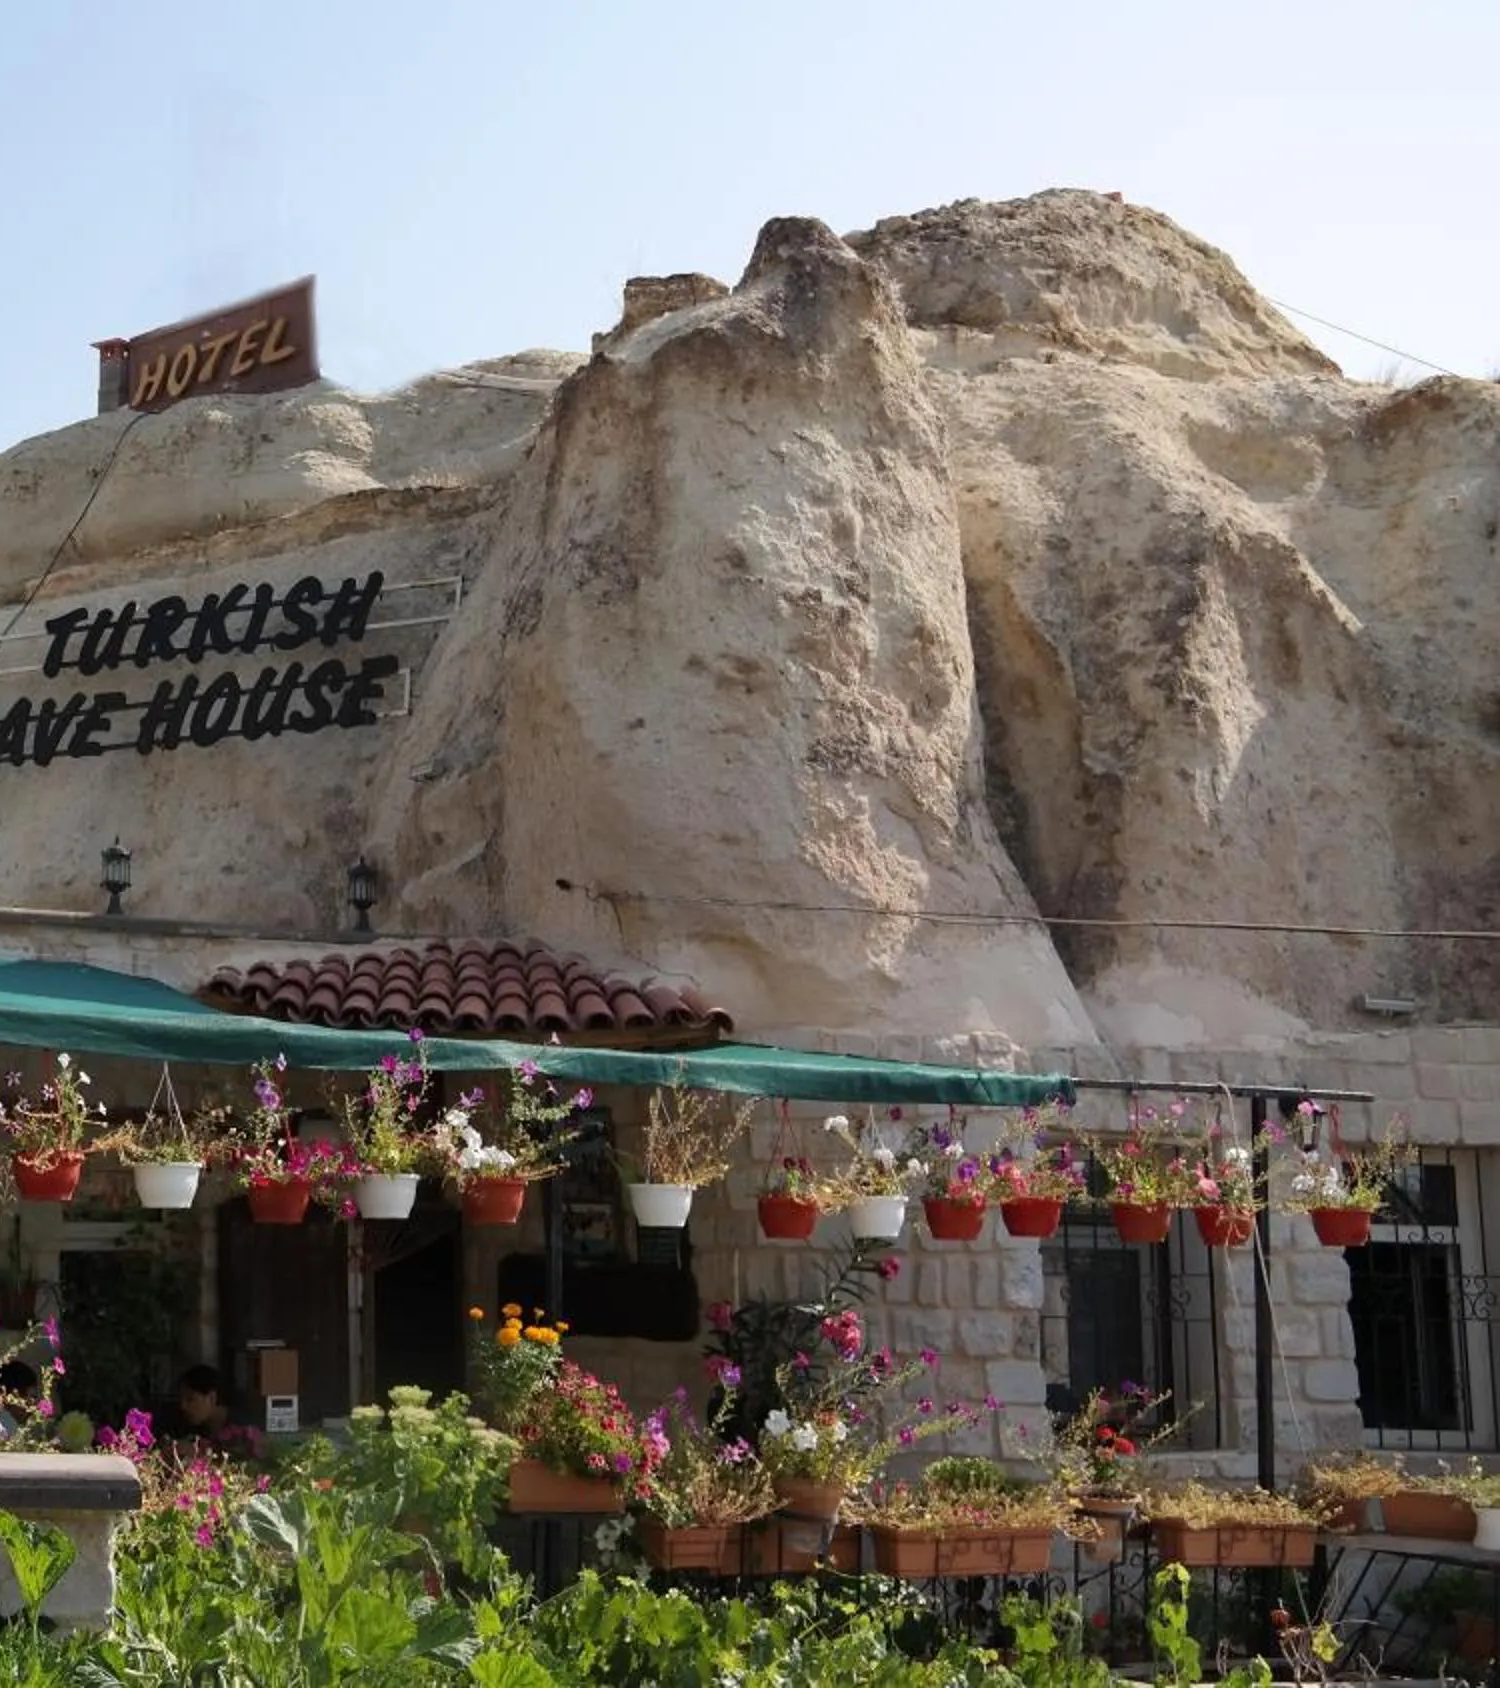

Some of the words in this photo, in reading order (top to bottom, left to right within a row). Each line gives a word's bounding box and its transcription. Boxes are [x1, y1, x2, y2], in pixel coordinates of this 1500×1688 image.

[132, 316, 295, 406] HOTEL
[43, 571, 384, 678] TURKISH
[137, 655, 398, 755] HOUSE
